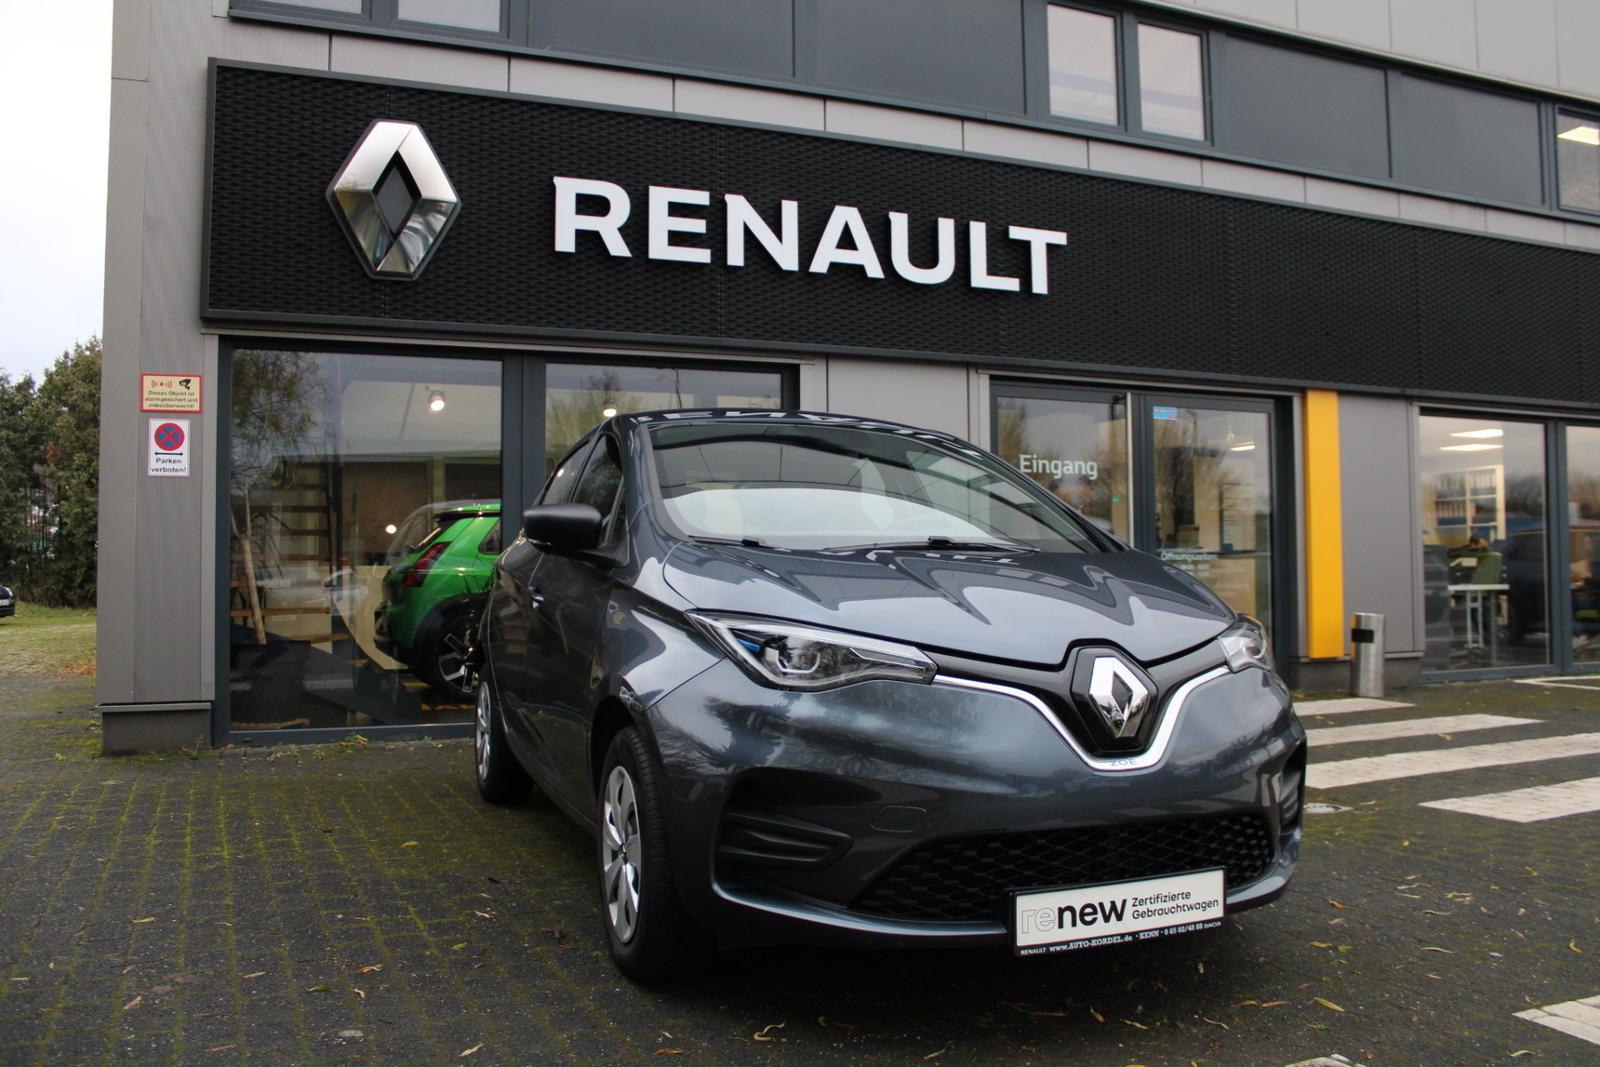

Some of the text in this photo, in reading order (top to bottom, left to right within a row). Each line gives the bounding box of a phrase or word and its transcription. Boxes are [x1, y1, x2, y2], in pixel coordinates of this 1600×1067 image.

[552, 176, 1068, 295] RENAULT
[1019, 454, 1098, 480] Eingang
[1110, 758, 1138, 767] ZOE
[1131, 891, 1191, 907] Zertifizierte
[1131, 898, 1219, 920] Gebrauchtwagen
[1021, 898, 1127, 935] renew
[1020, 947, 1047, 956] RENAULT
[1204, 921, 1222, 929] DACIA
